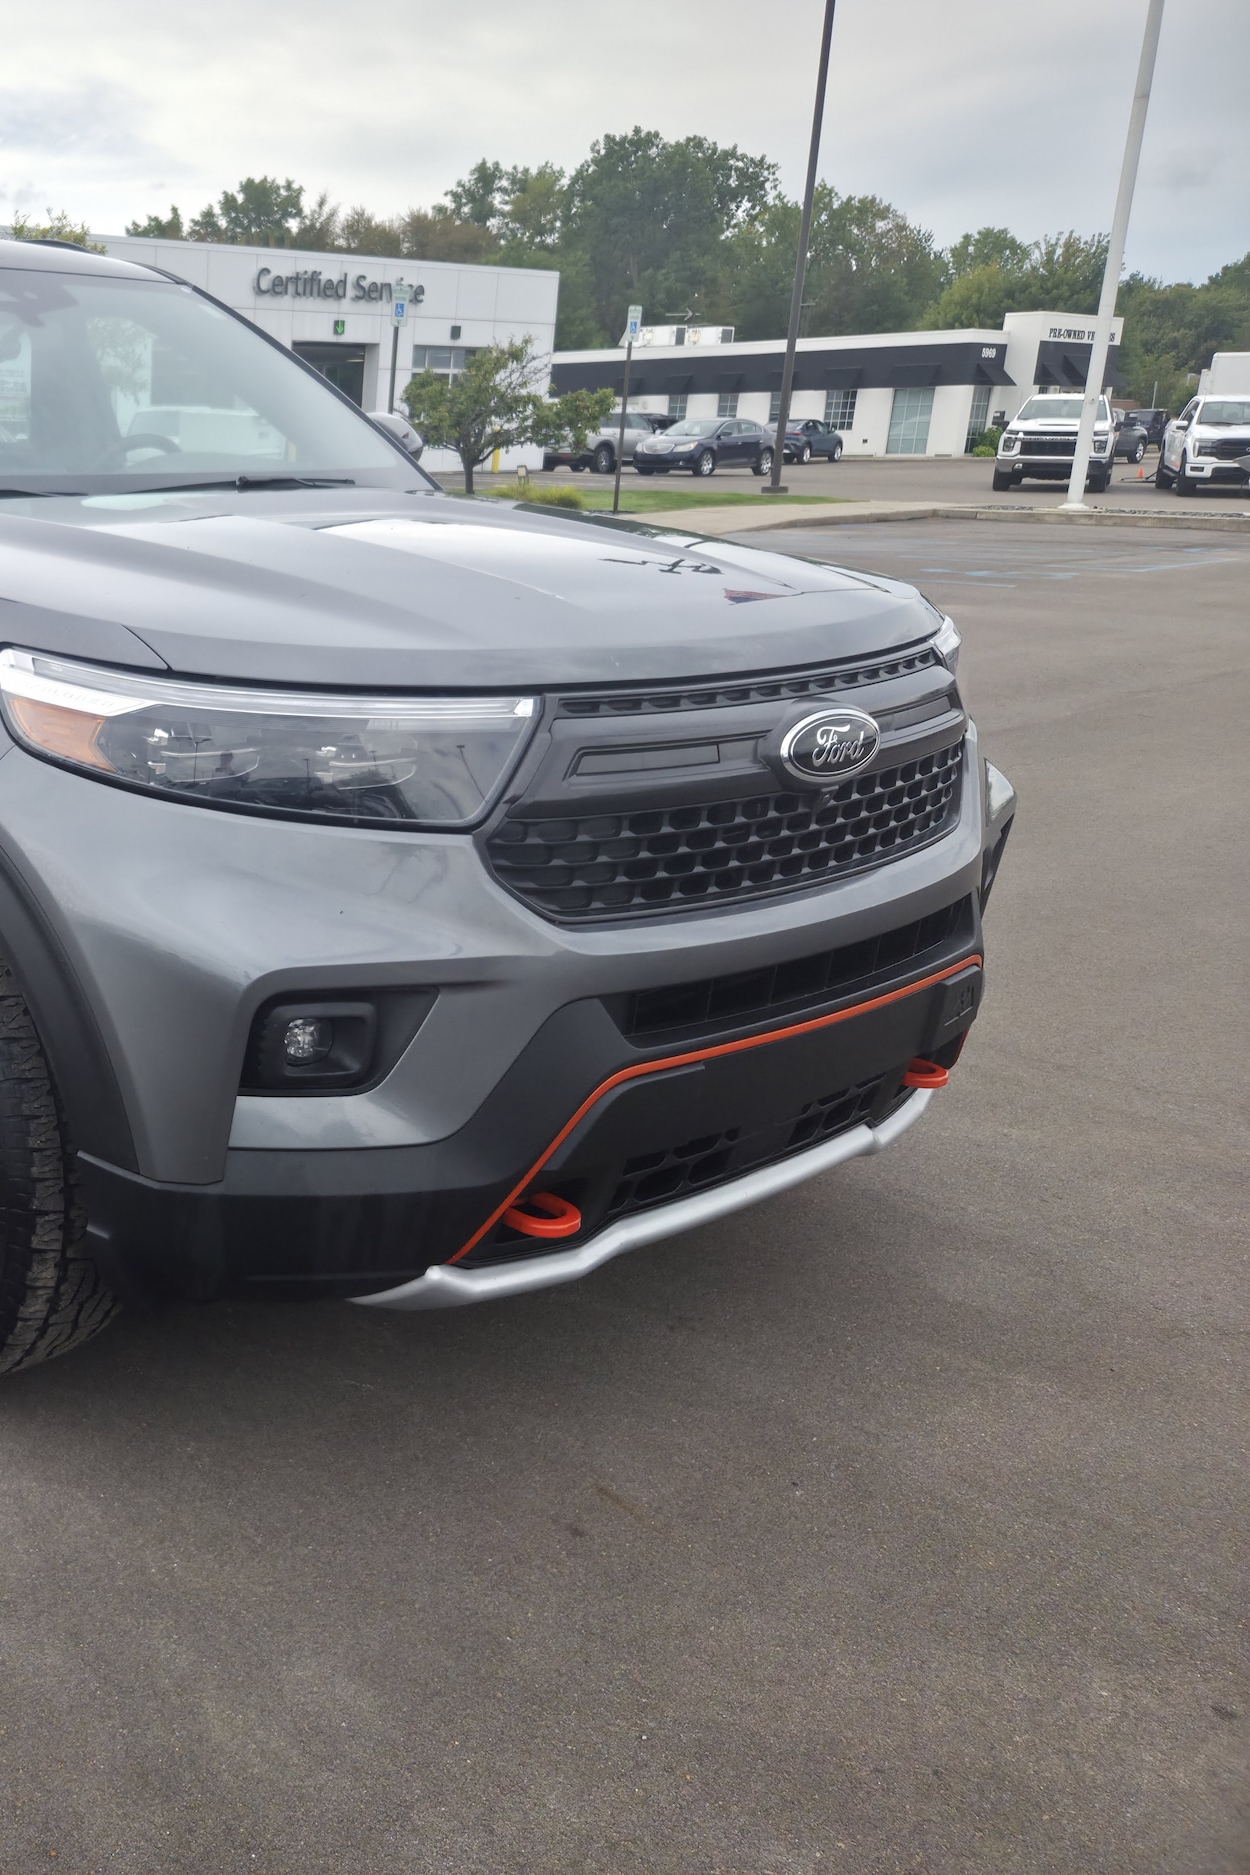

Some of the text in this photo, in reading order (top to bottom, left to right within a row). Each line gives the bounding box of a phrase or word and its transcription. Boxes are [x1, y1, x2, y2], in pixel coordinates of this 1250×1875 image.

[256, 267, 425, 303] Certified Serce
[1049, 328, 1086, 340] PRE-OWNED
[812, 724, 865, 767] Ford
